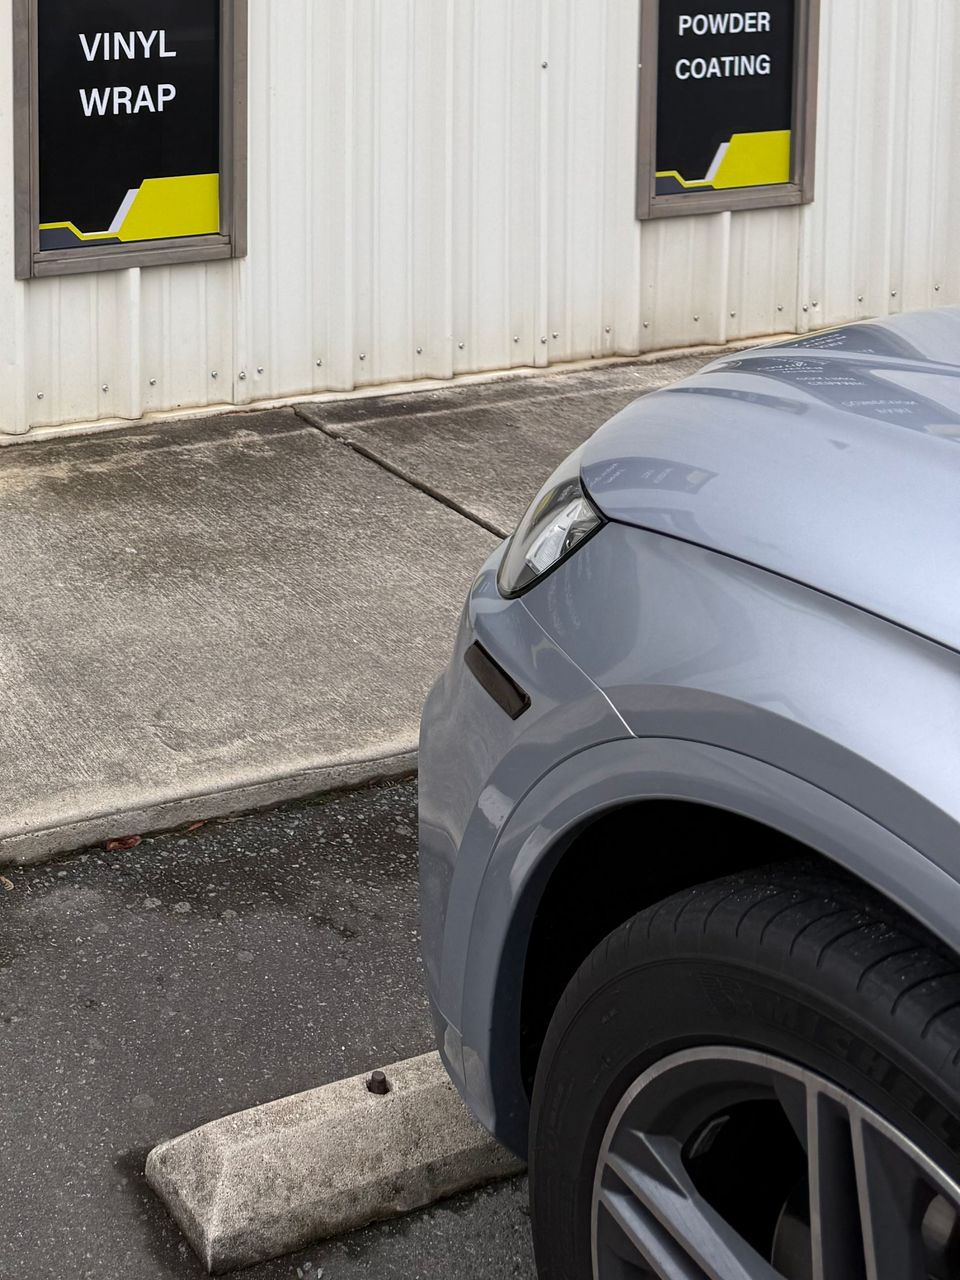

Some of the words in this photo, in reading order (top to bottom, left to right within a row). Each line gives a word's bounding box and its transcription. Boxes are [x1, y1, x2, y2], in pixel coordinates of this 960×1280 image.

[678, 11, 771, 36] POWDER
[78, 29, 177, 62] VINYL
[675, 54, 771, 80] COATING
[79, 83, 176, 117] WRAP
